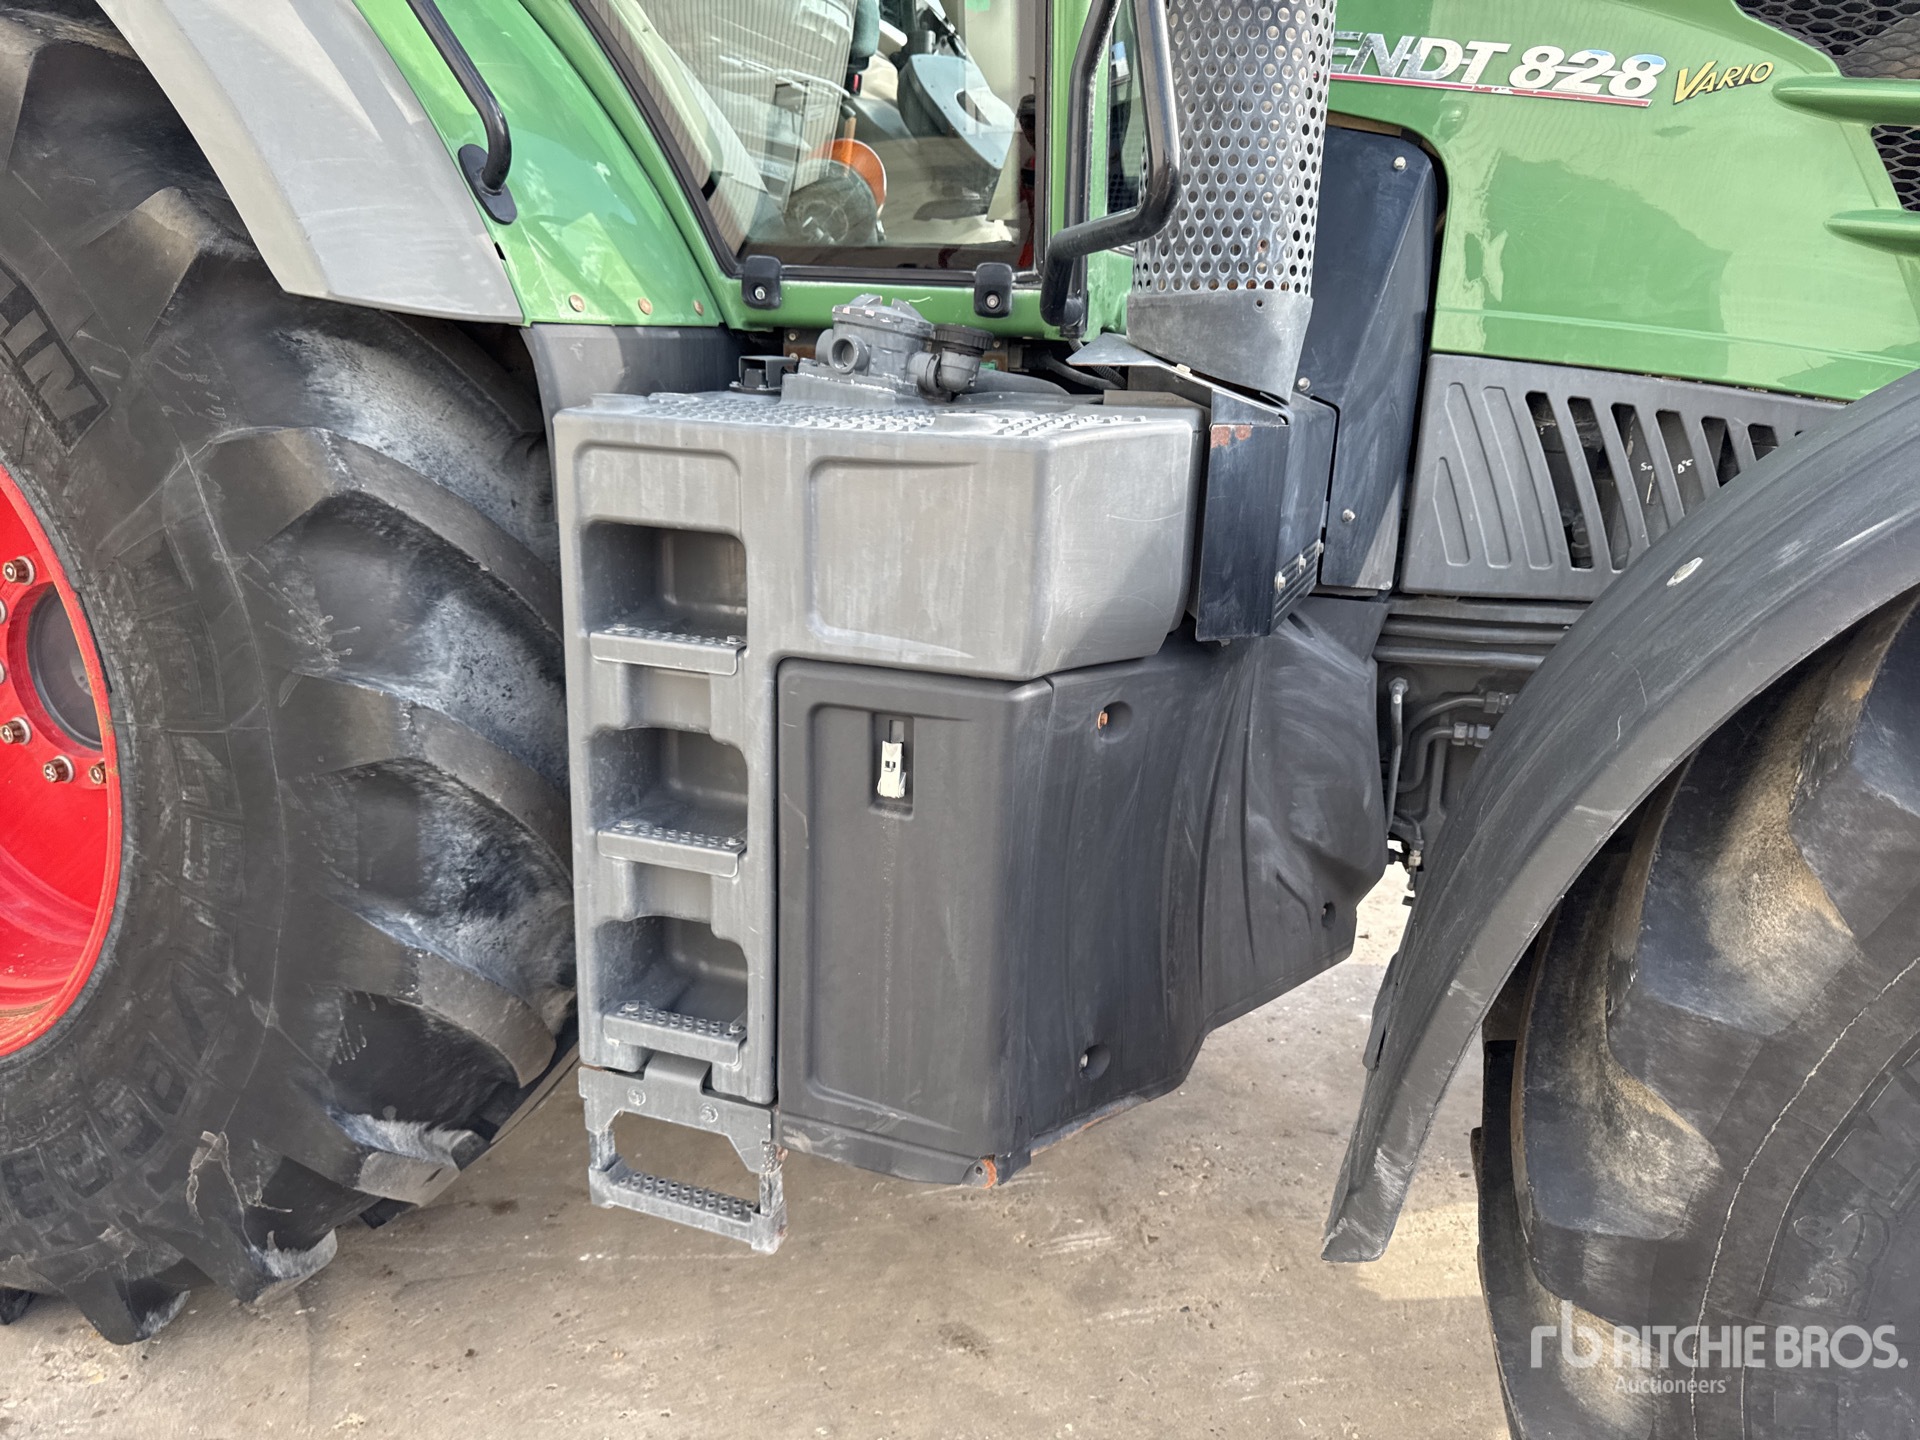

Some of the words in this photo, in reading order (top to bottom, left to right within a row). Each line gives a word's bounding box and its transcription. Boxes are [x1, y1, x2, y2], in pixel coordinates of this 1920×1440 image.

[1330, 32, 1511, 83] ENDT
[1508, 45, 1667, 98] 828
[1672, 60, 1775, 105] VARIO
